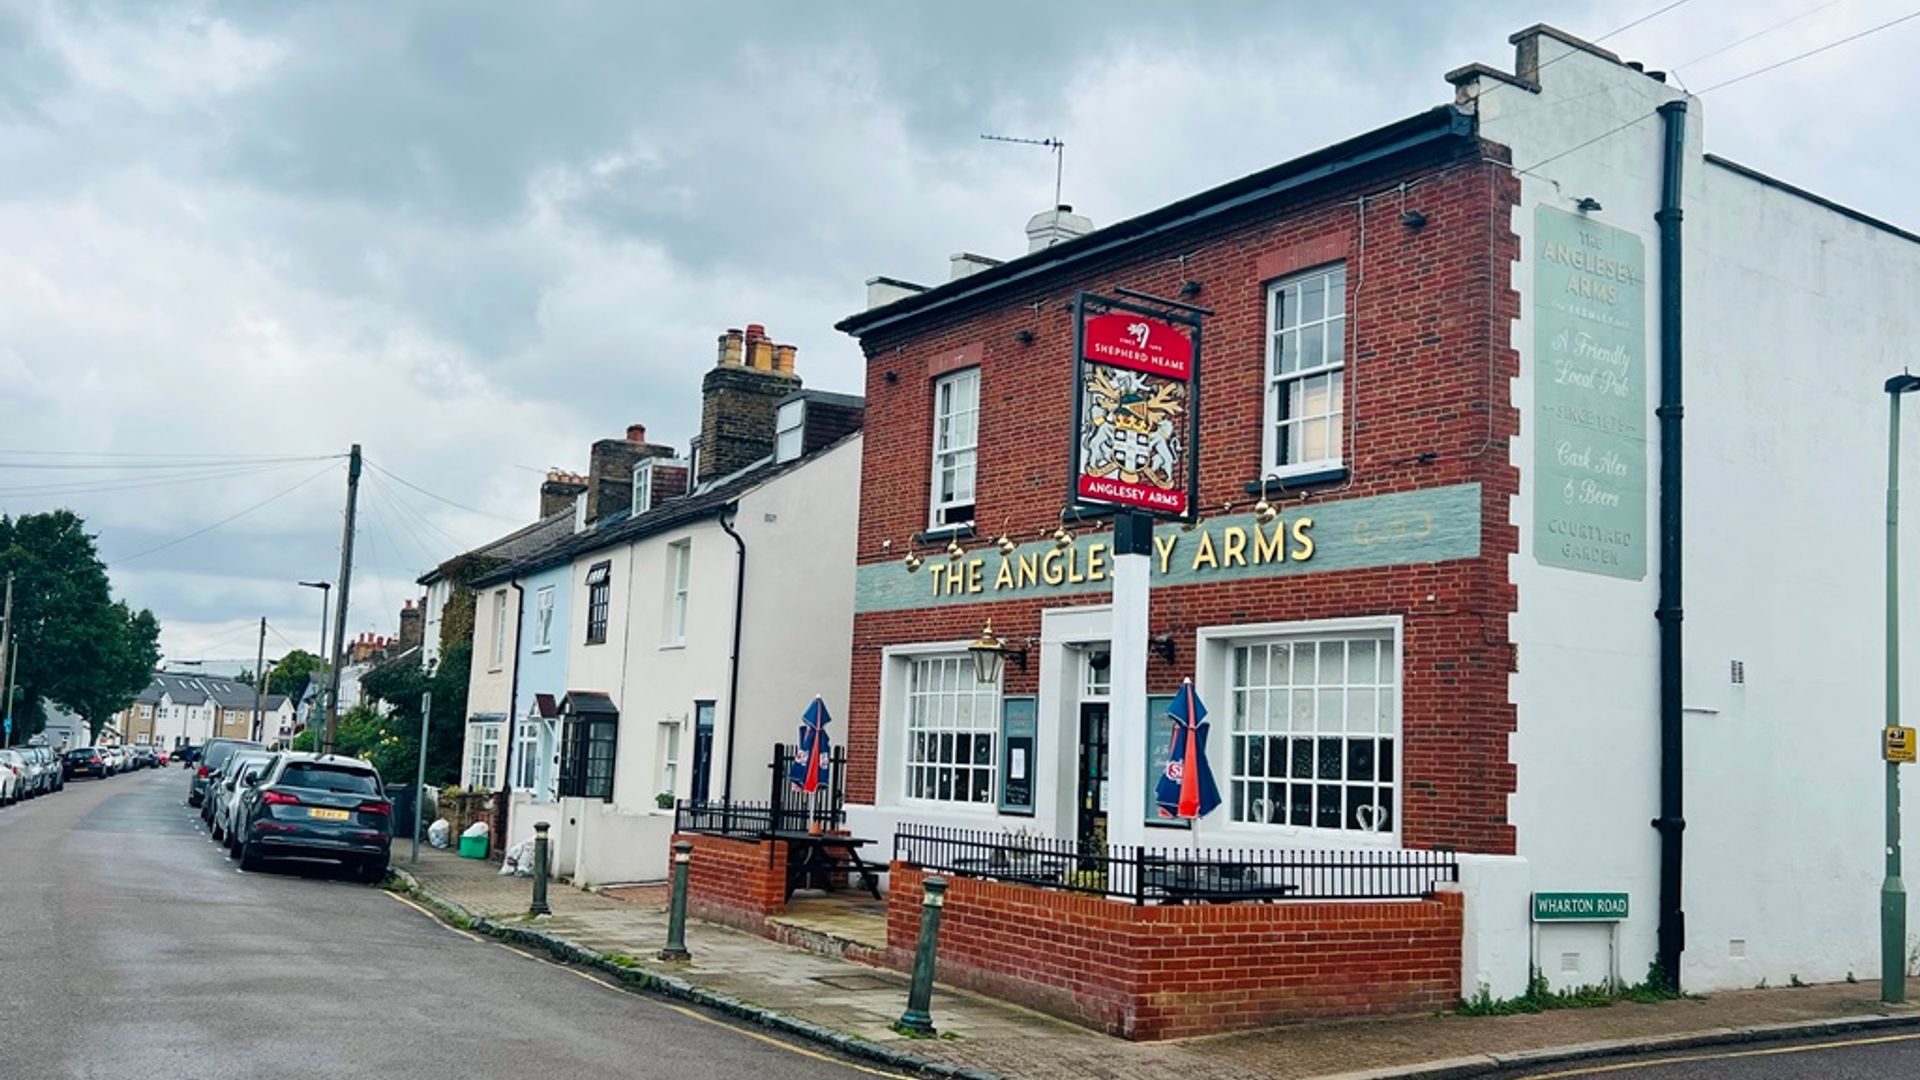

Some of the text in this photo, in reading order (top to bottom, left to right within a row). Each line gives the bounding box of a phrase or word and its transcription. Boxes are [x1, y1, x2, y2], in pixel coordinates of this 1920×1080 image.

[1542, 240, 1635, 286] ANGLESEY
[1566, 275, 1617, 305] ARMS
[1094, 343, 1185, 371] SHEPHERD NEAME
[1574, 331, 1631, 379] Friendly
[1554, 359, 1629, 397] Local Pub
[1594, 450, 1627, 477] Ales
[1088, 481, 1179, 506] ANGLESEY ARMS
[1578, 478, 1620, 508] Beers
[929, 558, 983, 597] THE
[993, 533, 1178, 591] ANGLEY
[1191, 517, 1315, 571] ARMS
[1537, 898, 1627, 913] WHARTON ROAD
